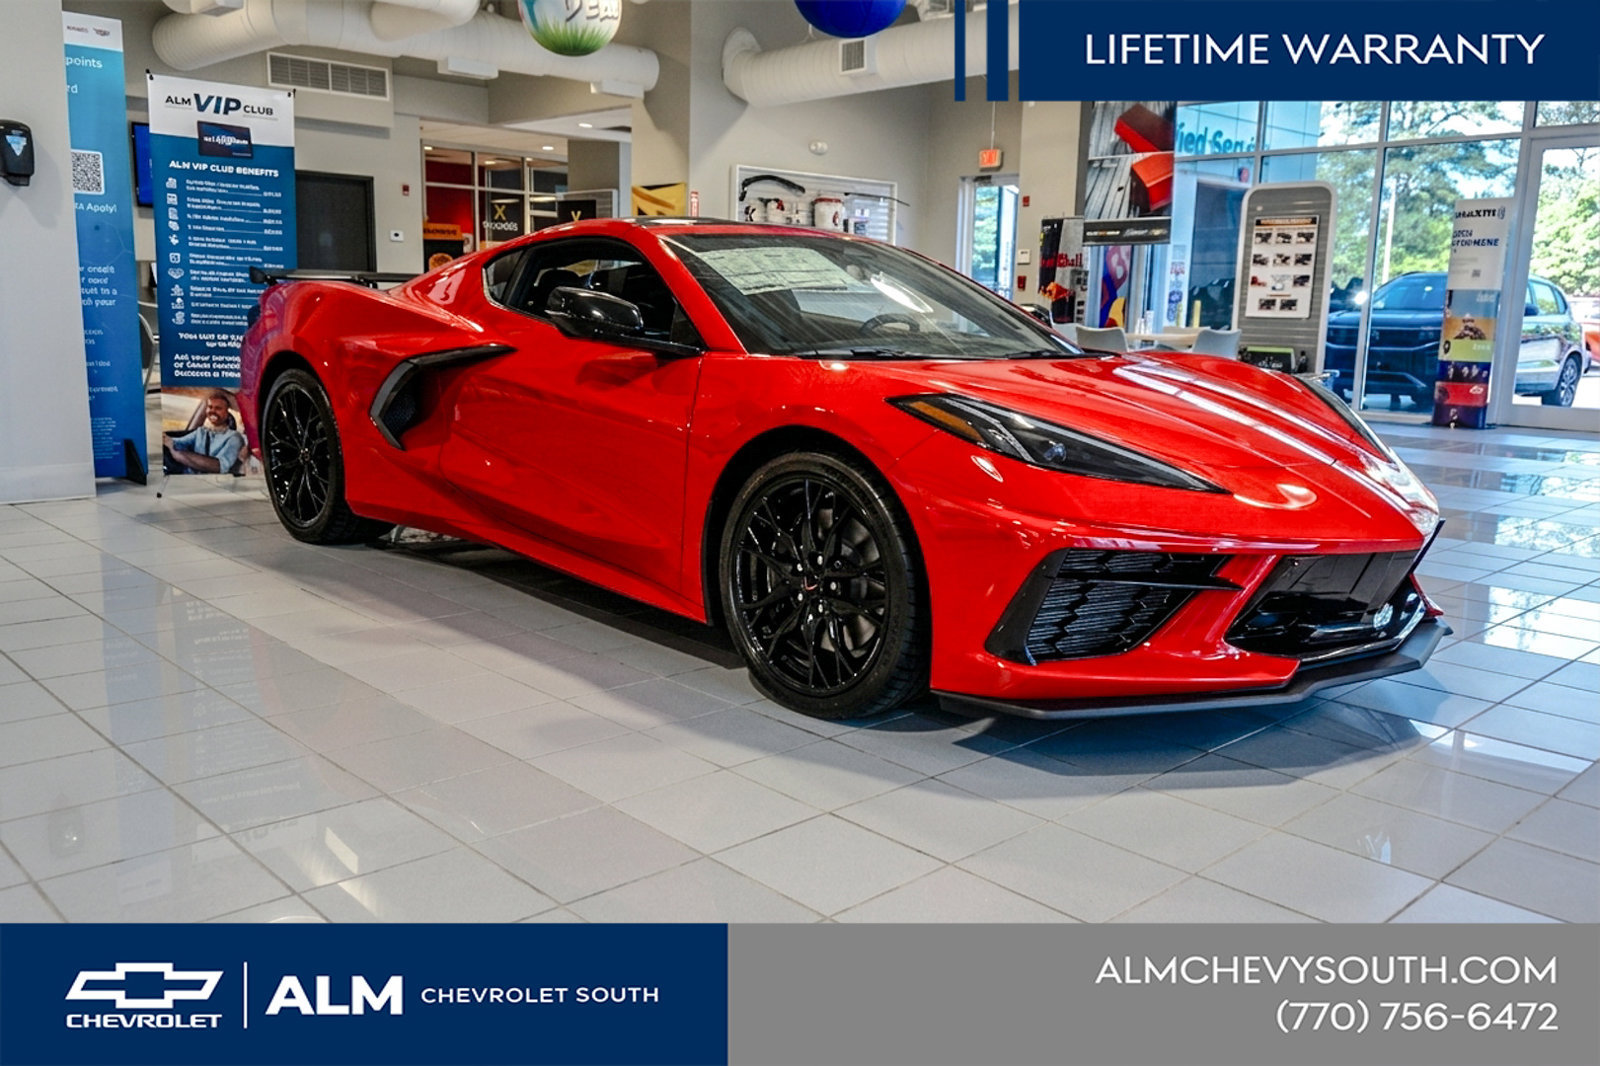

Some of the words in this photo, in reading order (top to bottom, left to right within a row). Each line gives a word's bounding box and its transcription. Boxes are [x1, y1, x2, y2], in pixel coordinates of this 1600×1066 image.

[65, 56, 103, 69] points
[165, 95, 192, 106] ALM
[193, 93, 242, 116] VIP
[243, 105, 274, 116] CLUB
[192, 162, 208, 171] VIP
[235, 166, 279, 177] BENEFITS
